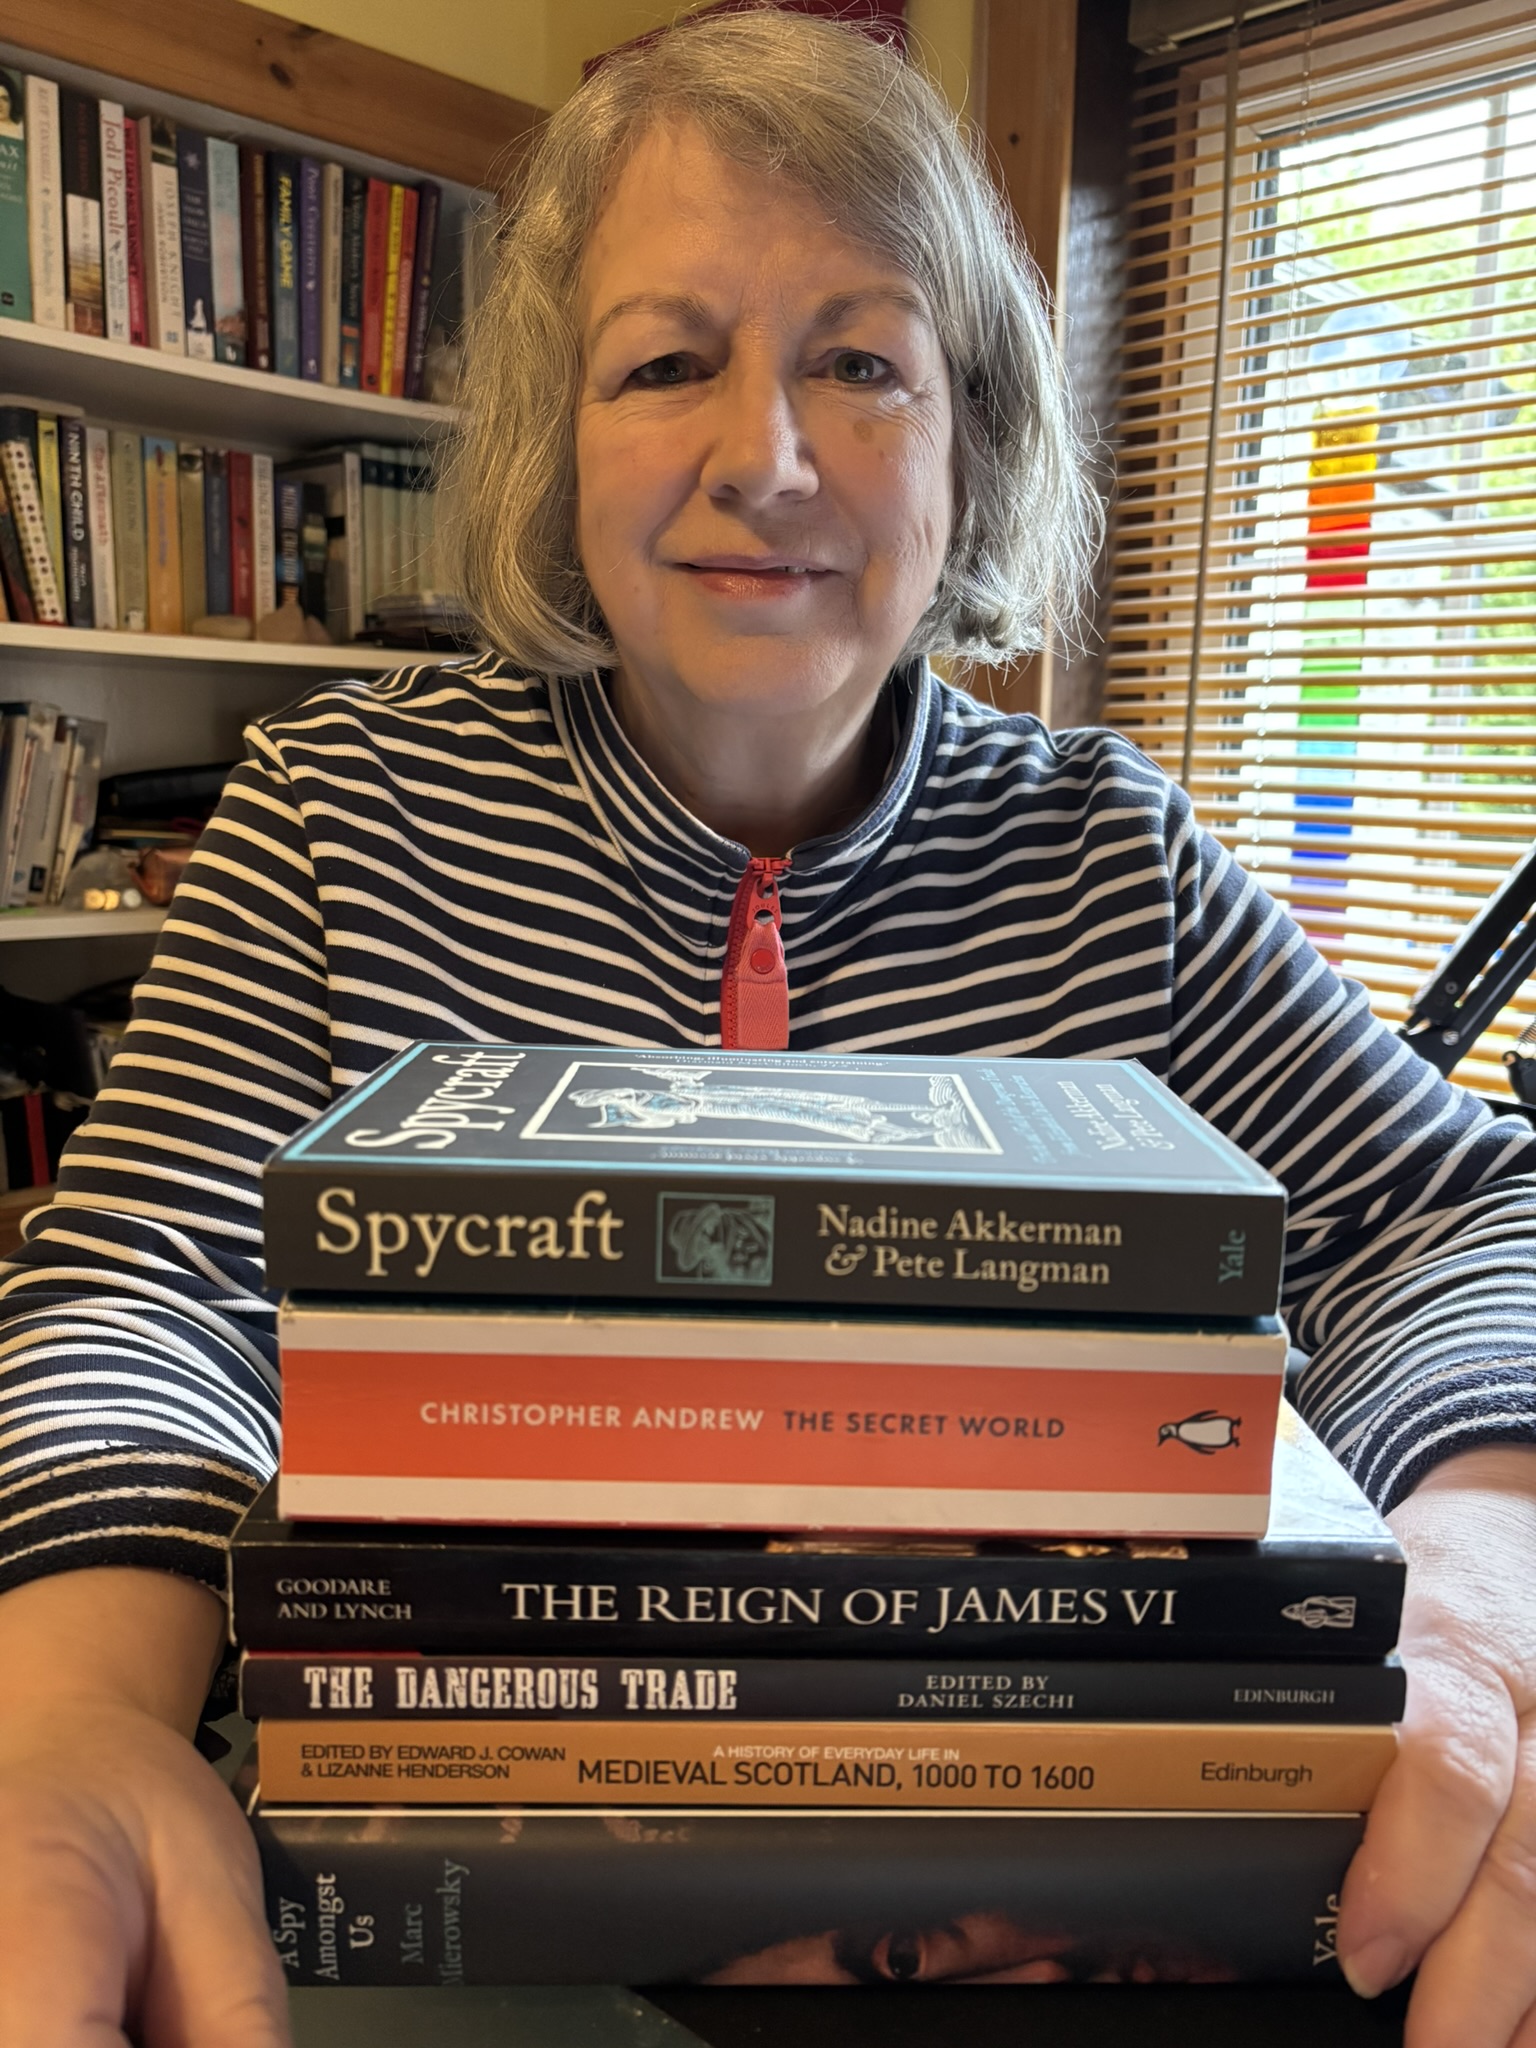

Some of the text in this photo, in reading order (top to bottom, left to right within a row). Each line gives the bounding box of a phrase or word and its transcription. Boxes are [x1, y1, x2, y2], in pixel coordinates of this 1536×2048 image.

[102, 117, 123, 235] Jodi Picoult
[278, 176, 293, 236] FAMILY
[156, 202, 169, 303] JAMES ROBERTSON
[164, 180, 182, 319] JOSEPH KNIGHT
[279, 239, 293, 289] GAME
[67, 433, 86, 541] NINTH CHILD
[344, 1051, 527, 1150] Spycraft
[1057, 1081, 1135, 1151] Nadine Akkerman
[1095, 1084, 1143, 1119] Langman
[316, 1187, 625, 1278] Spycraft
[817, 1204, 1122, 1247] Nadine Akkerman
[824, 1243, 1110, 1294] & Pete Langman
[1217, 1228, 1247, 1284] Yale
[420, 1400, 1065, 1439] CHRISTOPHER ANDREW THE SECRET WORLD
[276, 1577, 392, 1597] GOODARE
[501, 1583, 1179, 1634] THE REIGN OF JAMES VI
[277, 1602, 413, 1621] AND LYNCH
[303, 1666, 739, 1710] THE DANGEROUS TRADE
[898, 1693, 1075, 1709] DANIEL SZECHI
[926, 1675, 1049, 1691] EDITED BY
[1233, 1688, 1336, 1704] EDINBURGH
[301, 1744, 566, 1762] EDITED BY EDWARD J. COWAN
[301, 1763, 510, 1779] & LIZANNE HENDERSON
[578, 1759, 1095, 1791] MEDIEVAL SCOTLAND, 1000 TO 1600
[712, 1745, 960, 1761] A HISTORY OF EVERYDAY LIFE IN
[1201, 1761, 1313, 1787] Edinburgh
[273, 1896, 307, 1969] A Spy
[314, 1872, 345, 1981] Amongst
[350, 1914, 375, 1951] Us
[401, 1903, 424, 1965] Marc
